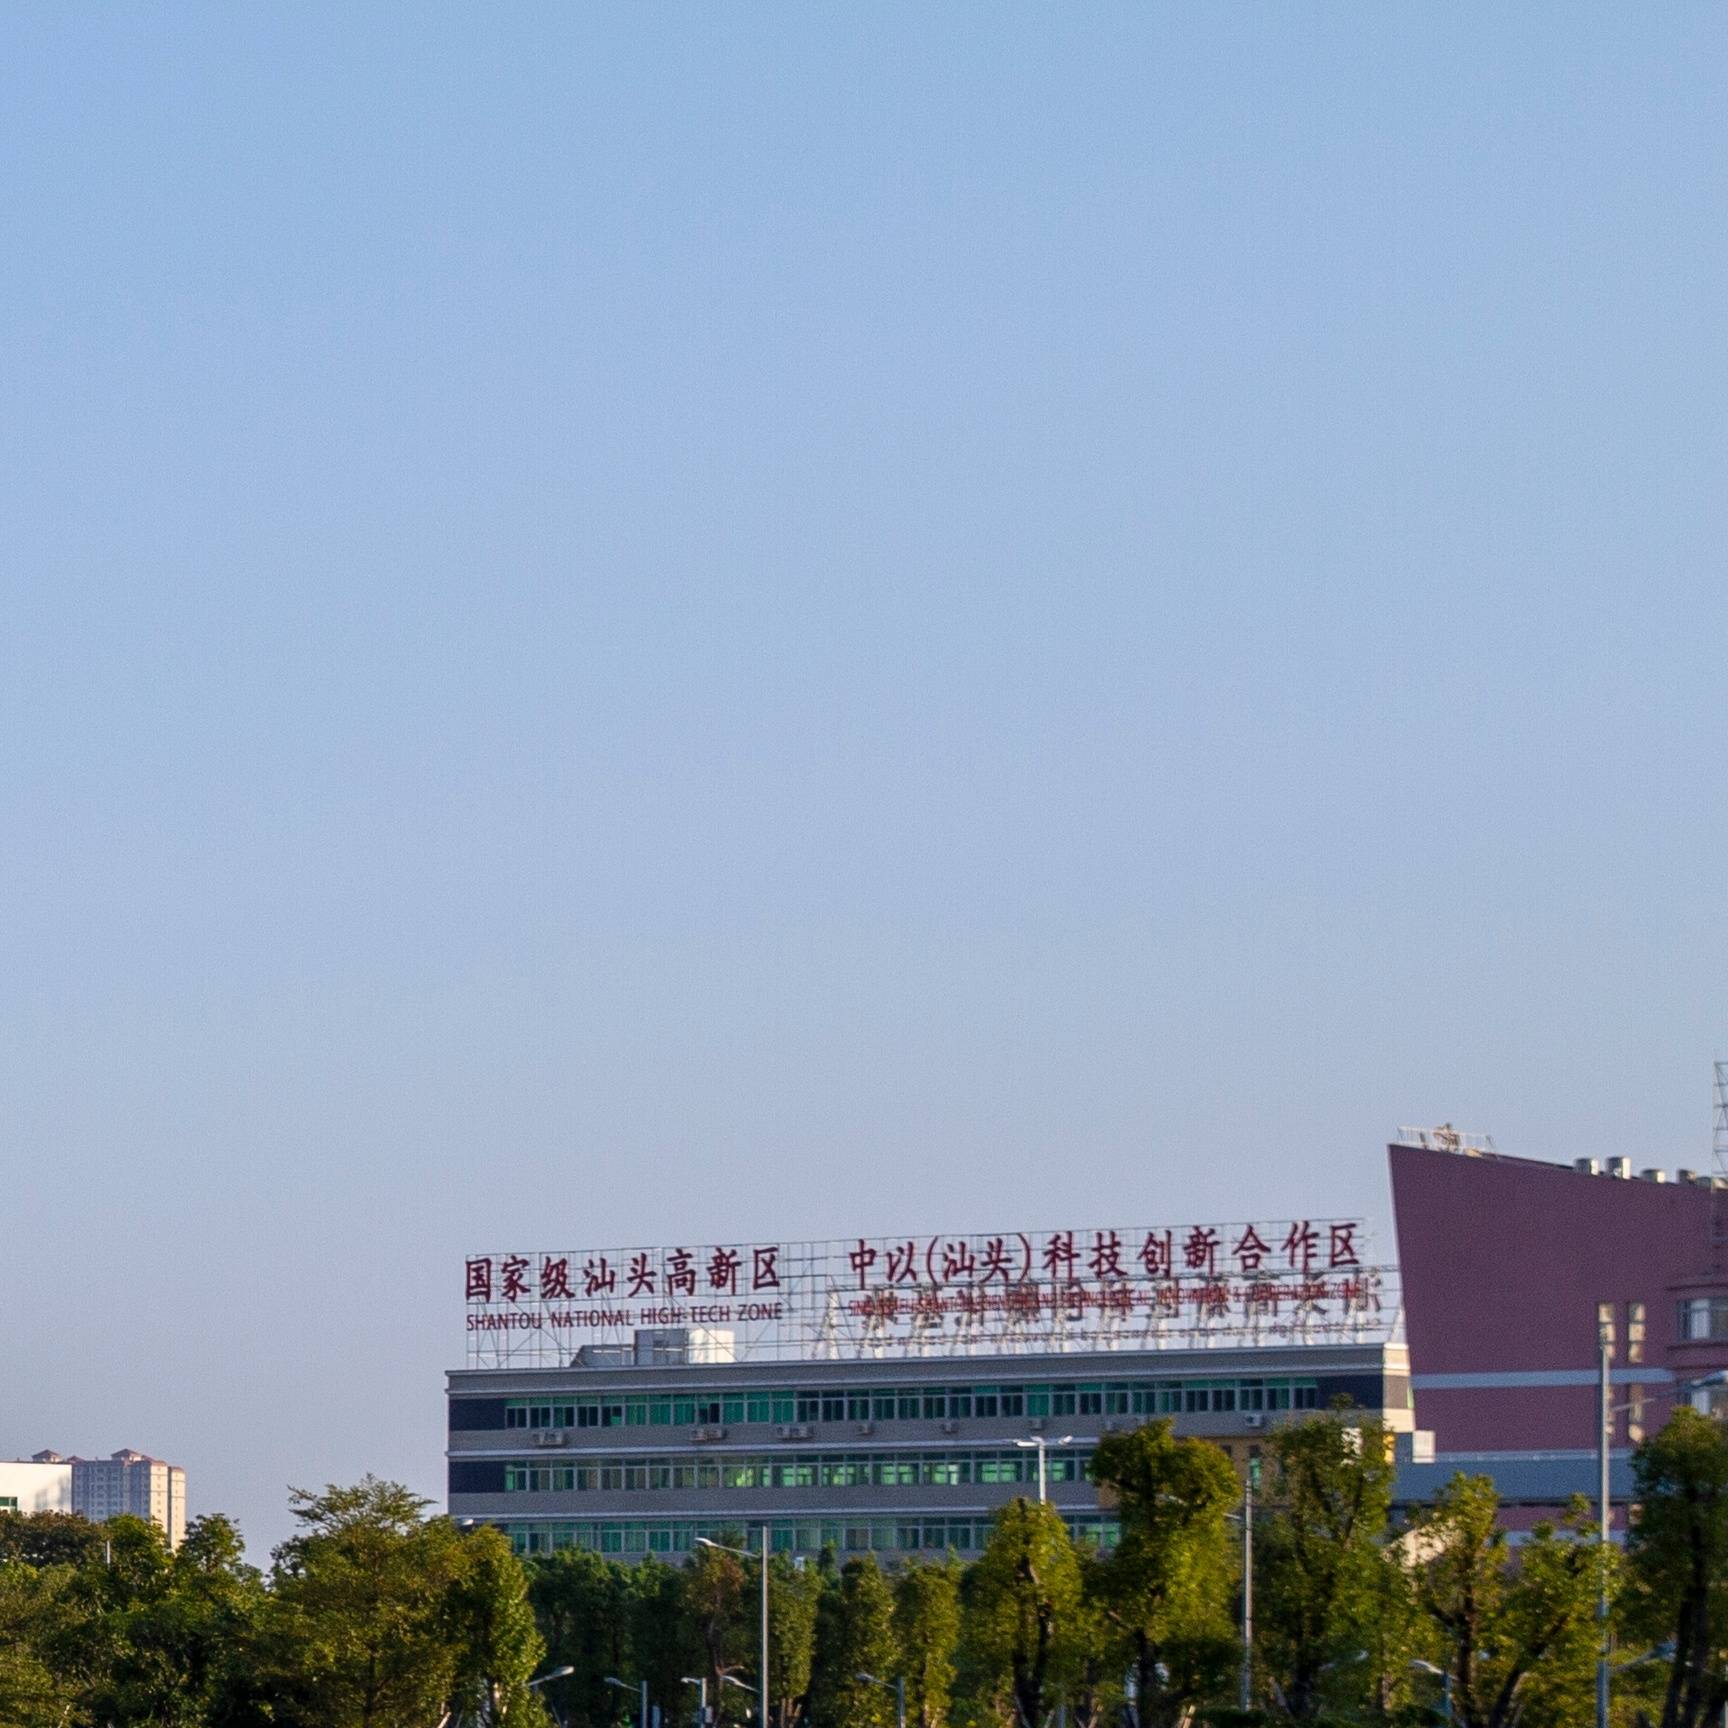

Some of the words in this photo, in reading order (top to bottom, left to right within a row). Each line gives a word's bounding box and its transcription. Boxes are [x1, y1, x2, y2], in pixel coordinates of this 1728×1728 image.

[465, 1246, 781, 1304] 国家级汕头高新区
[466, 1312, 542, 1332] SHANTOU
[550, 1308, 634, 1329] NATIONAL
[640, 1304, 731, 1325] HIGH-TECH
[737, 1302, 783, 1321] ZONE
